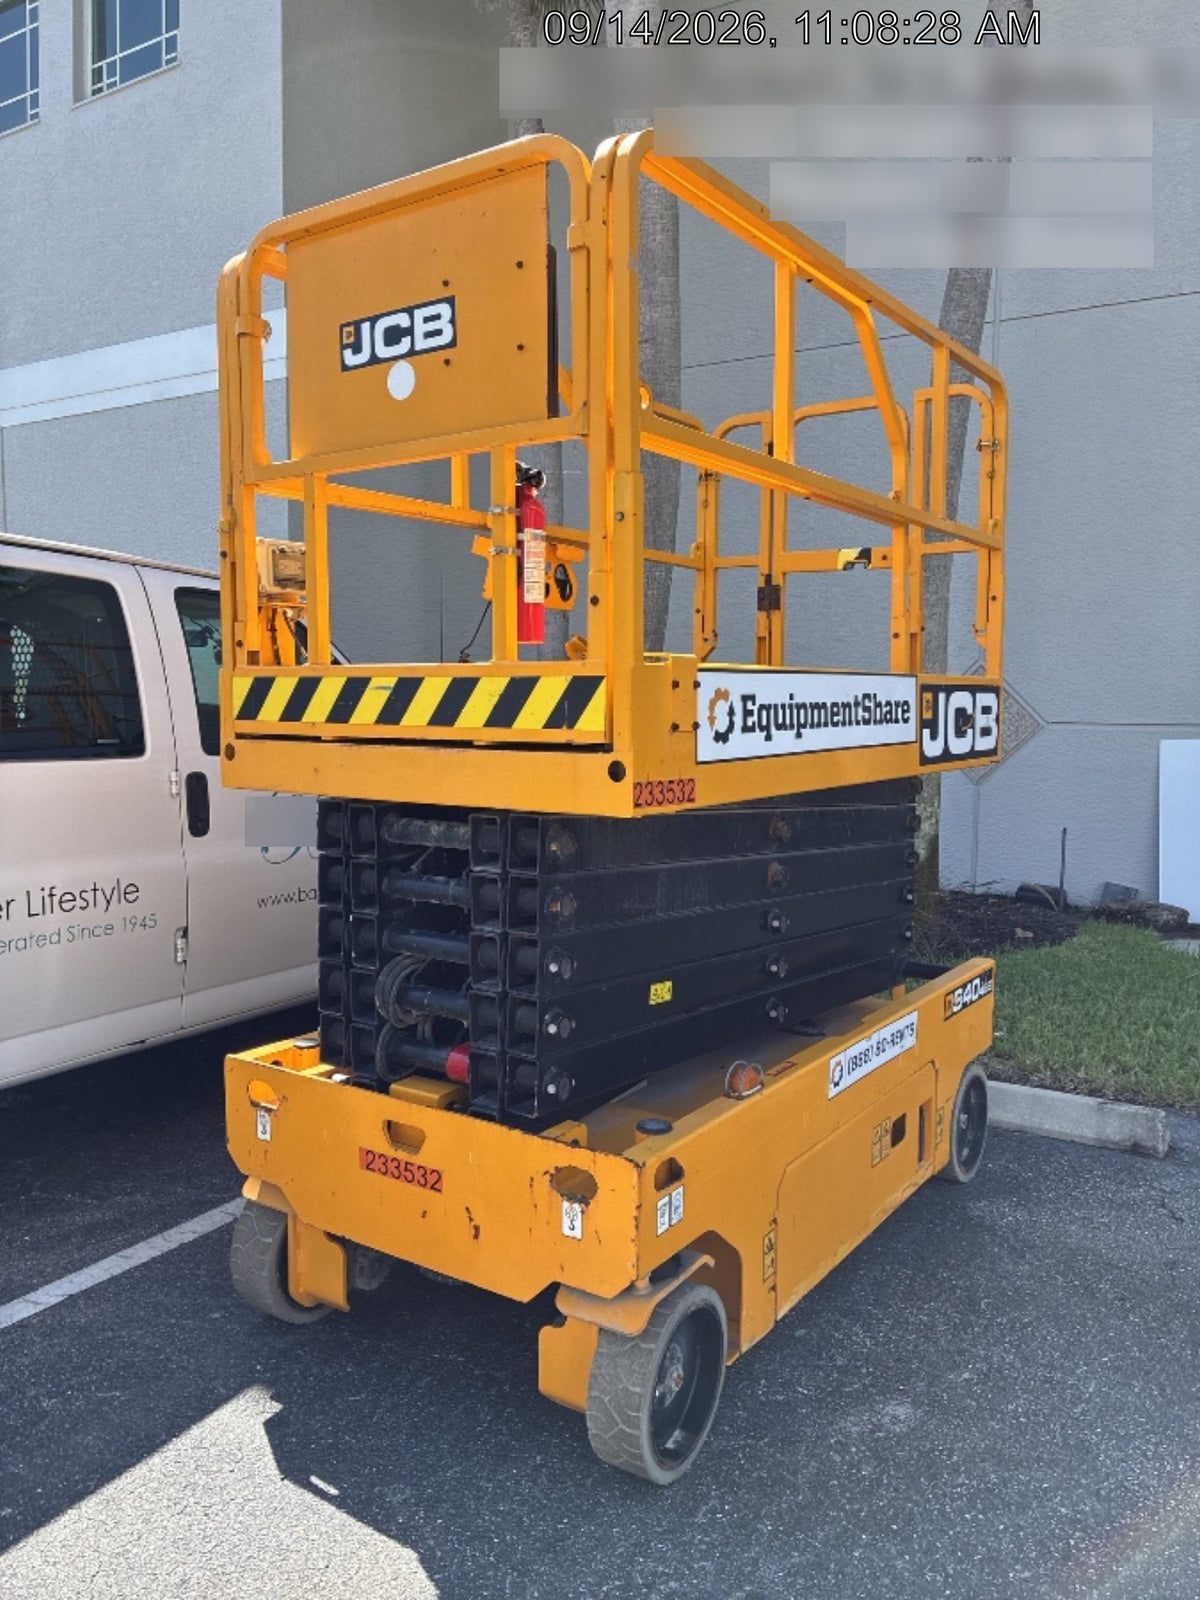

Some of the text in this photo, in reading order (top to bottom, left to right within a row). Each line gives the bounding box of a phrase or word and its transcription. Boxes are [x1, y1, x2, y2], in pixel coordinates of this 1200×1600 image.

[342, 302, 454, 367] JCB
[740, 692, 911, 742] EquipmentShare
[922, 690, 998, 758] JCB
[633, 778, 696, 808] 233532
[0, 877, 140, 922] r Lifestyle
[66, 923, 115, 944] Since
[122, 913, 158, 933] 1945
[365, 1149, 443, 1193] 233532
